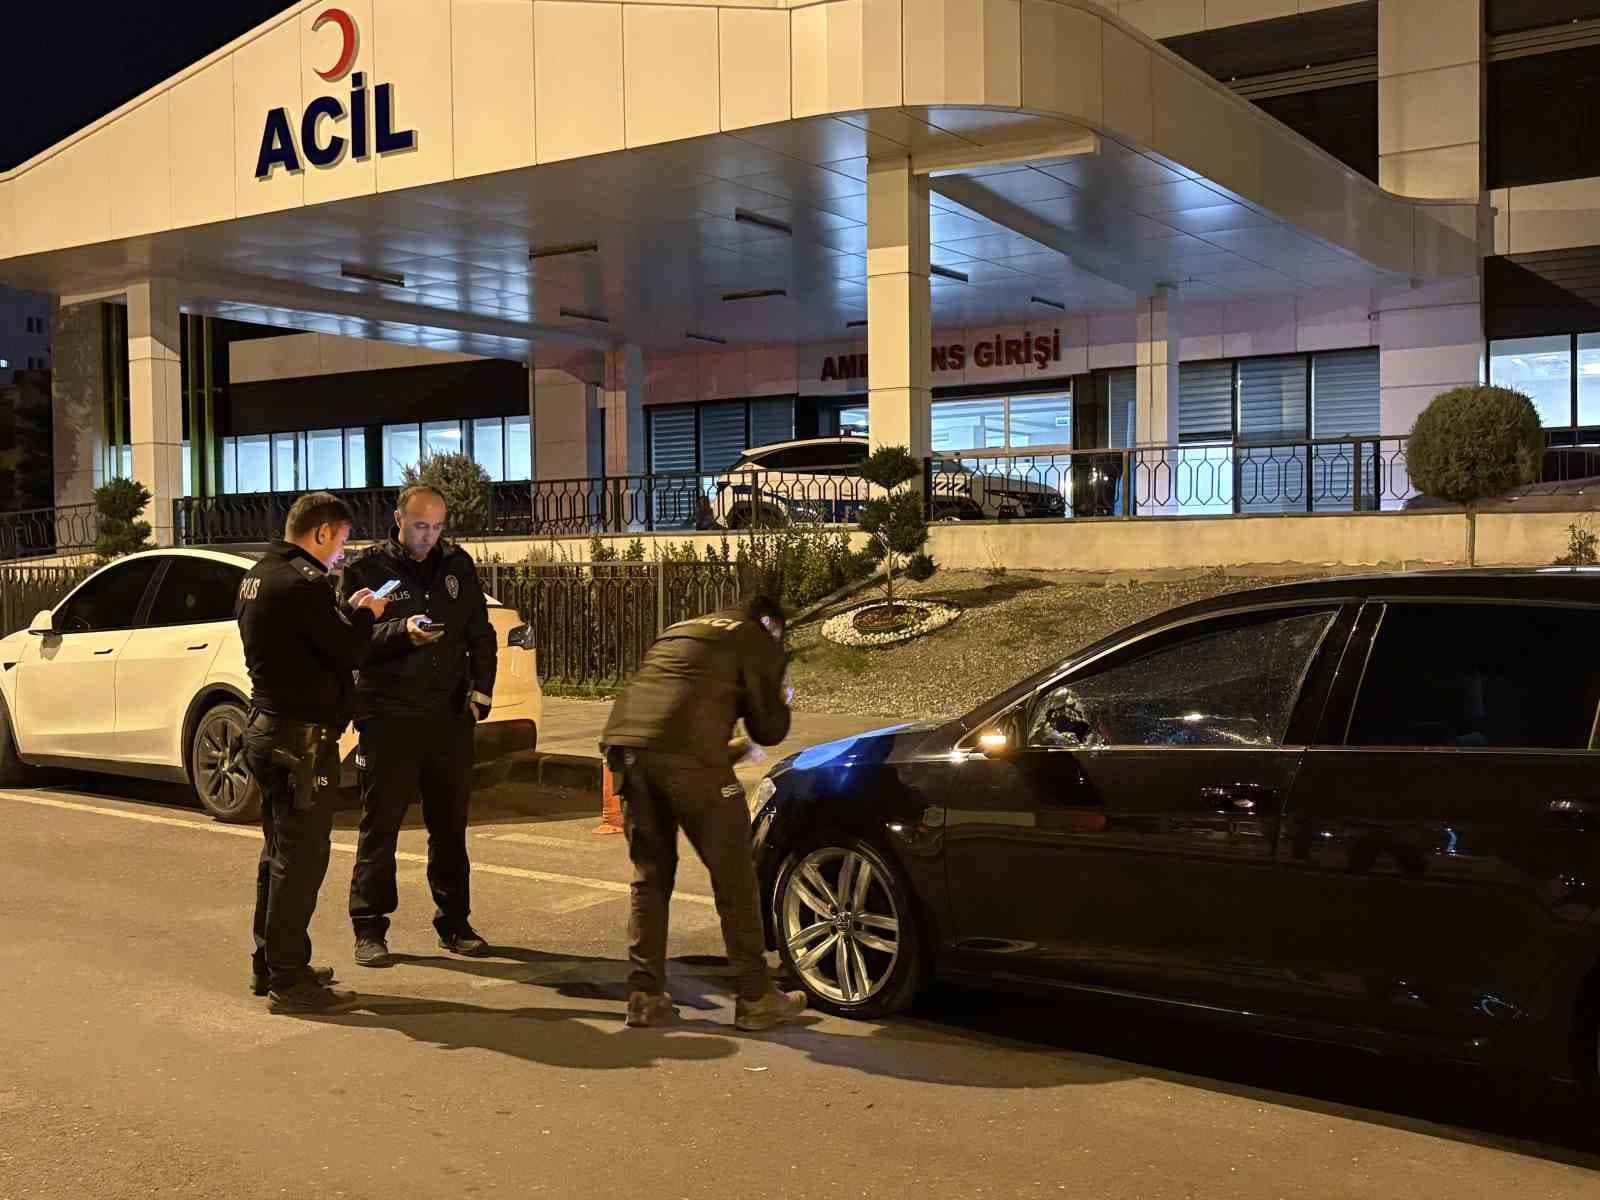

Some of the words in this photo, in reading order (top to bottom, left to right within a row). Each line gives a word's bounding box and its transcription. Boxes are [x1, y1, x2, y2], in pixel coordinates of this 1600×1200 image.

[255, 72, 417, 180] ACİL
[820, 344, 964, 381] AMNS
[974, 328, 1060, 370] GİRİŞİ
